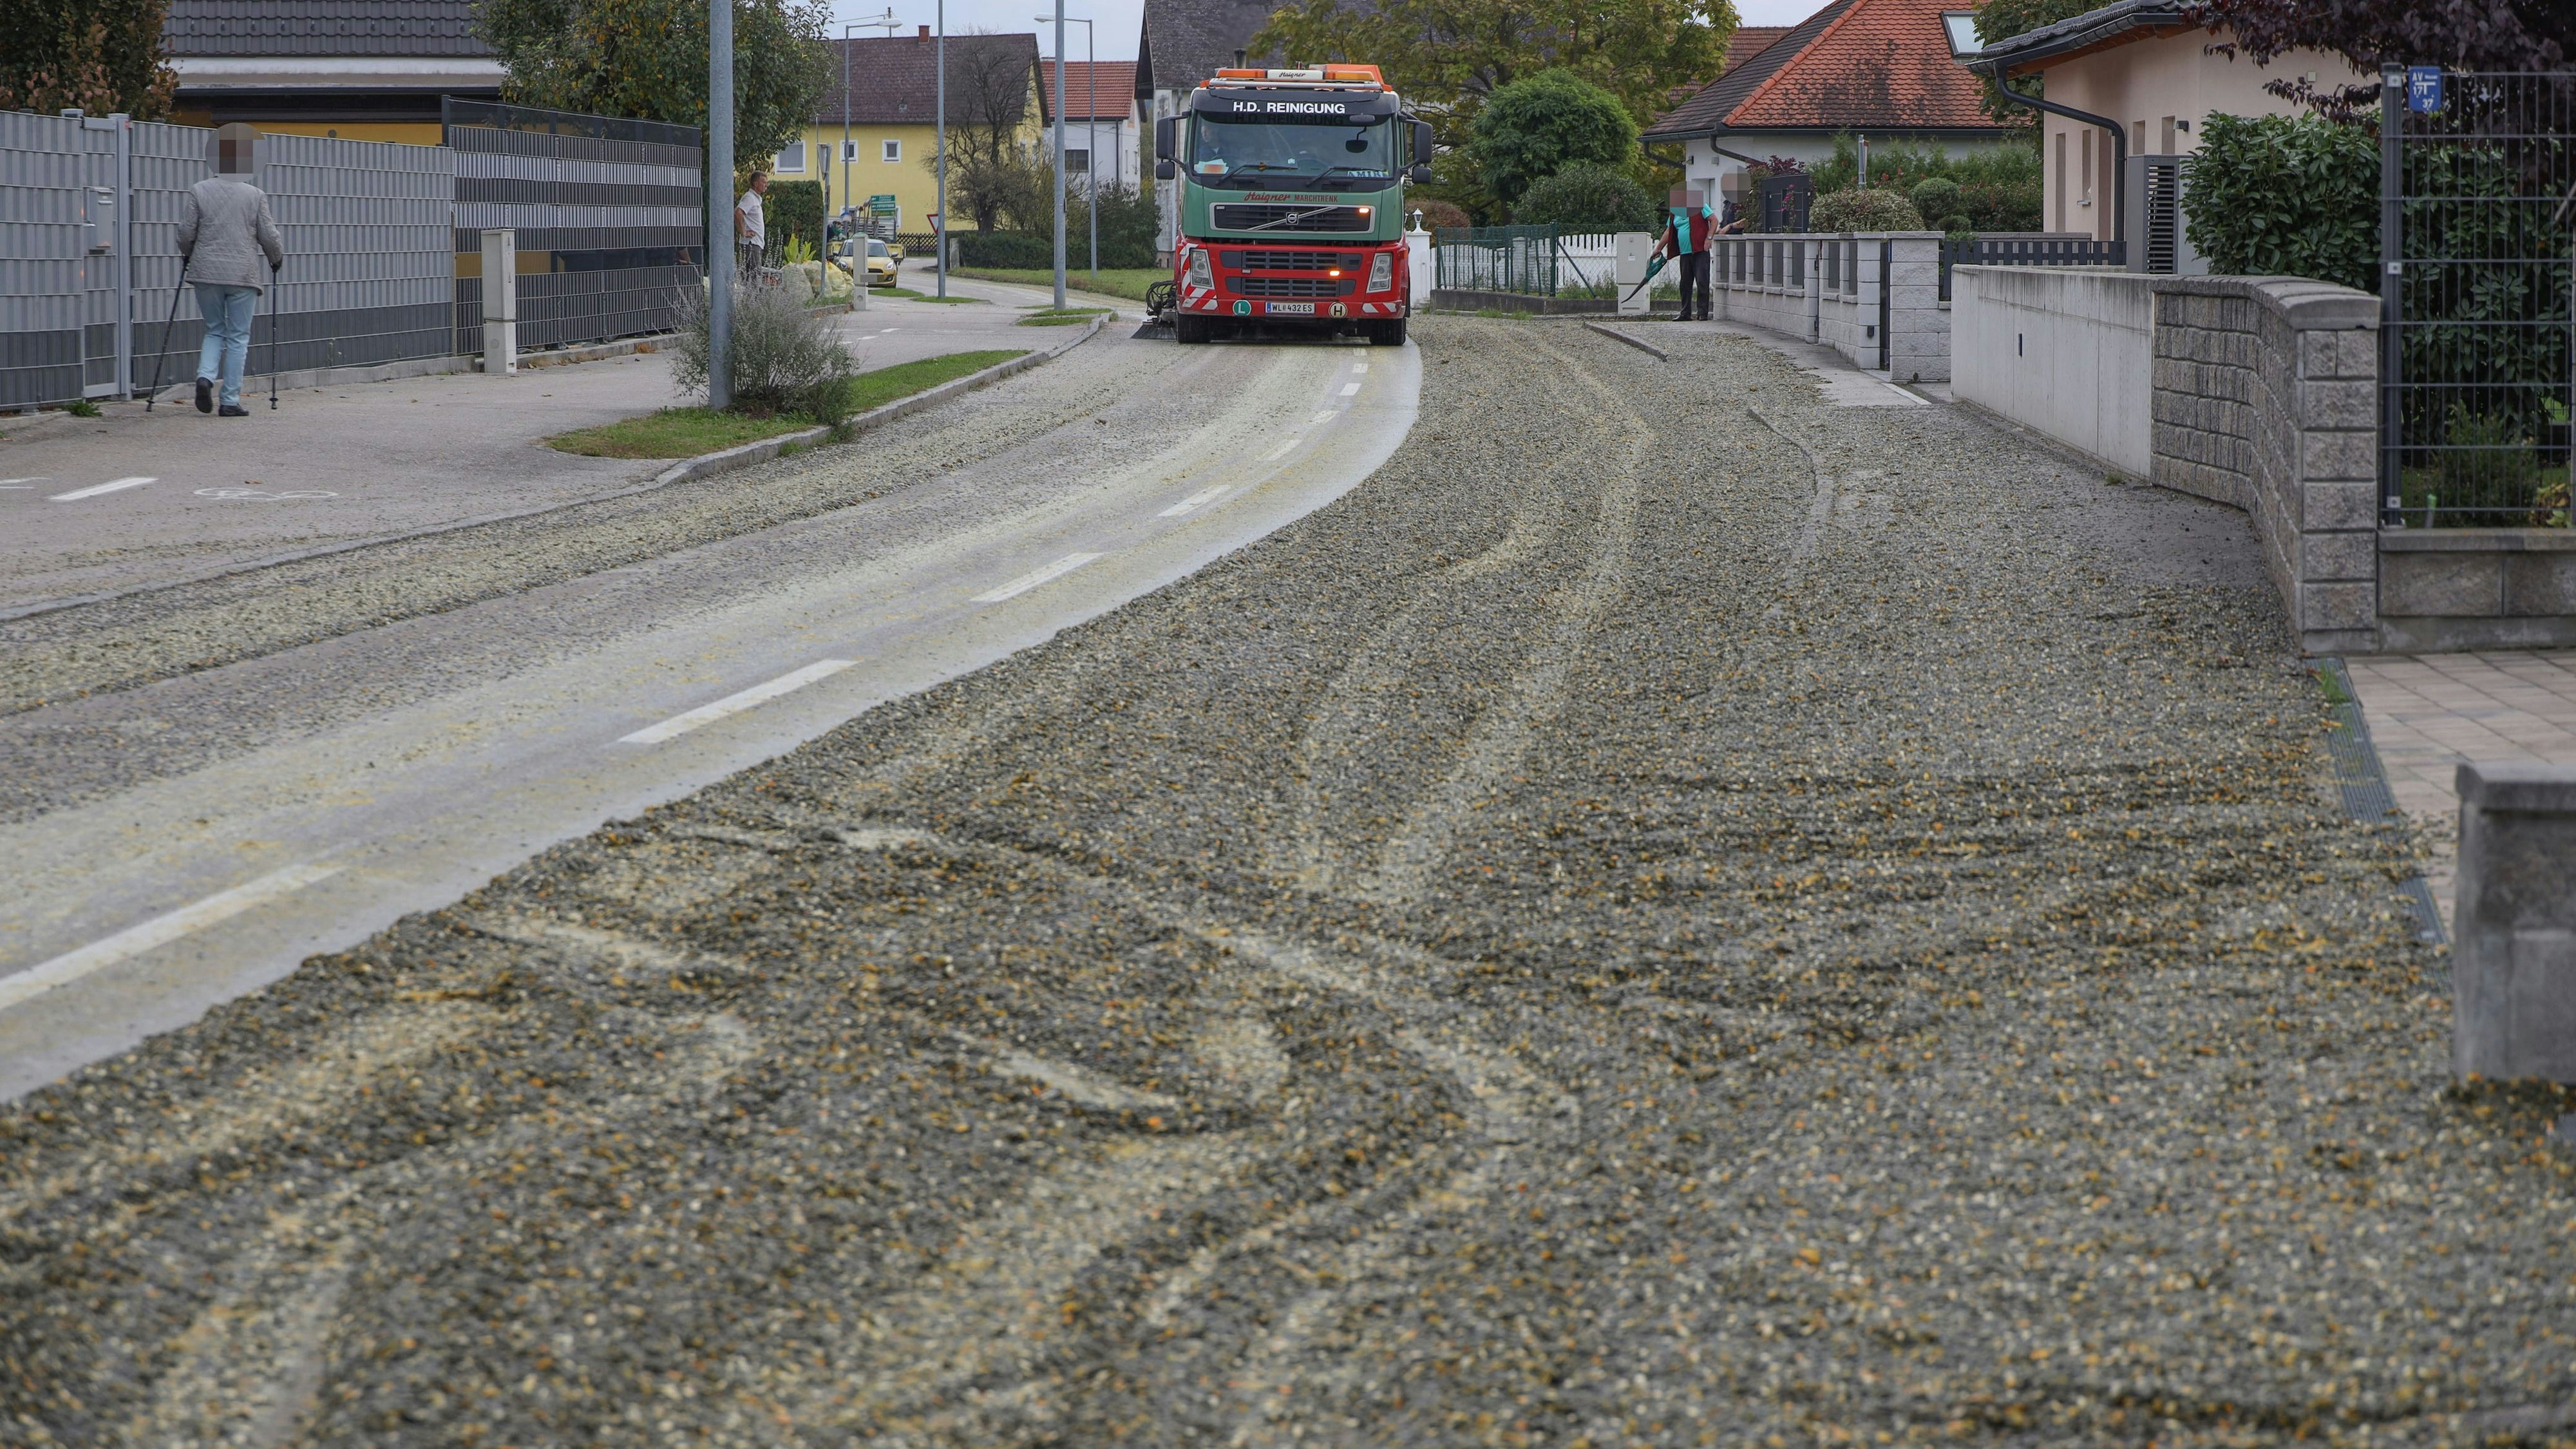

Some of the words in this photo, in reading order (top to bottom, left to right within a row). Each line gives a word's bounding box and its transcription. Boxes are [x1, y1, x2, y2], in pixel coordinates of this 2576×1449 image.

[1233, 101, 1261, 112] H.D.
[1266, 102, 1345, 114] REINIGUNG
[1244, 191, 1291, 204] Haigner
[1294, 194, 1338, 203] MARCHTRENK
